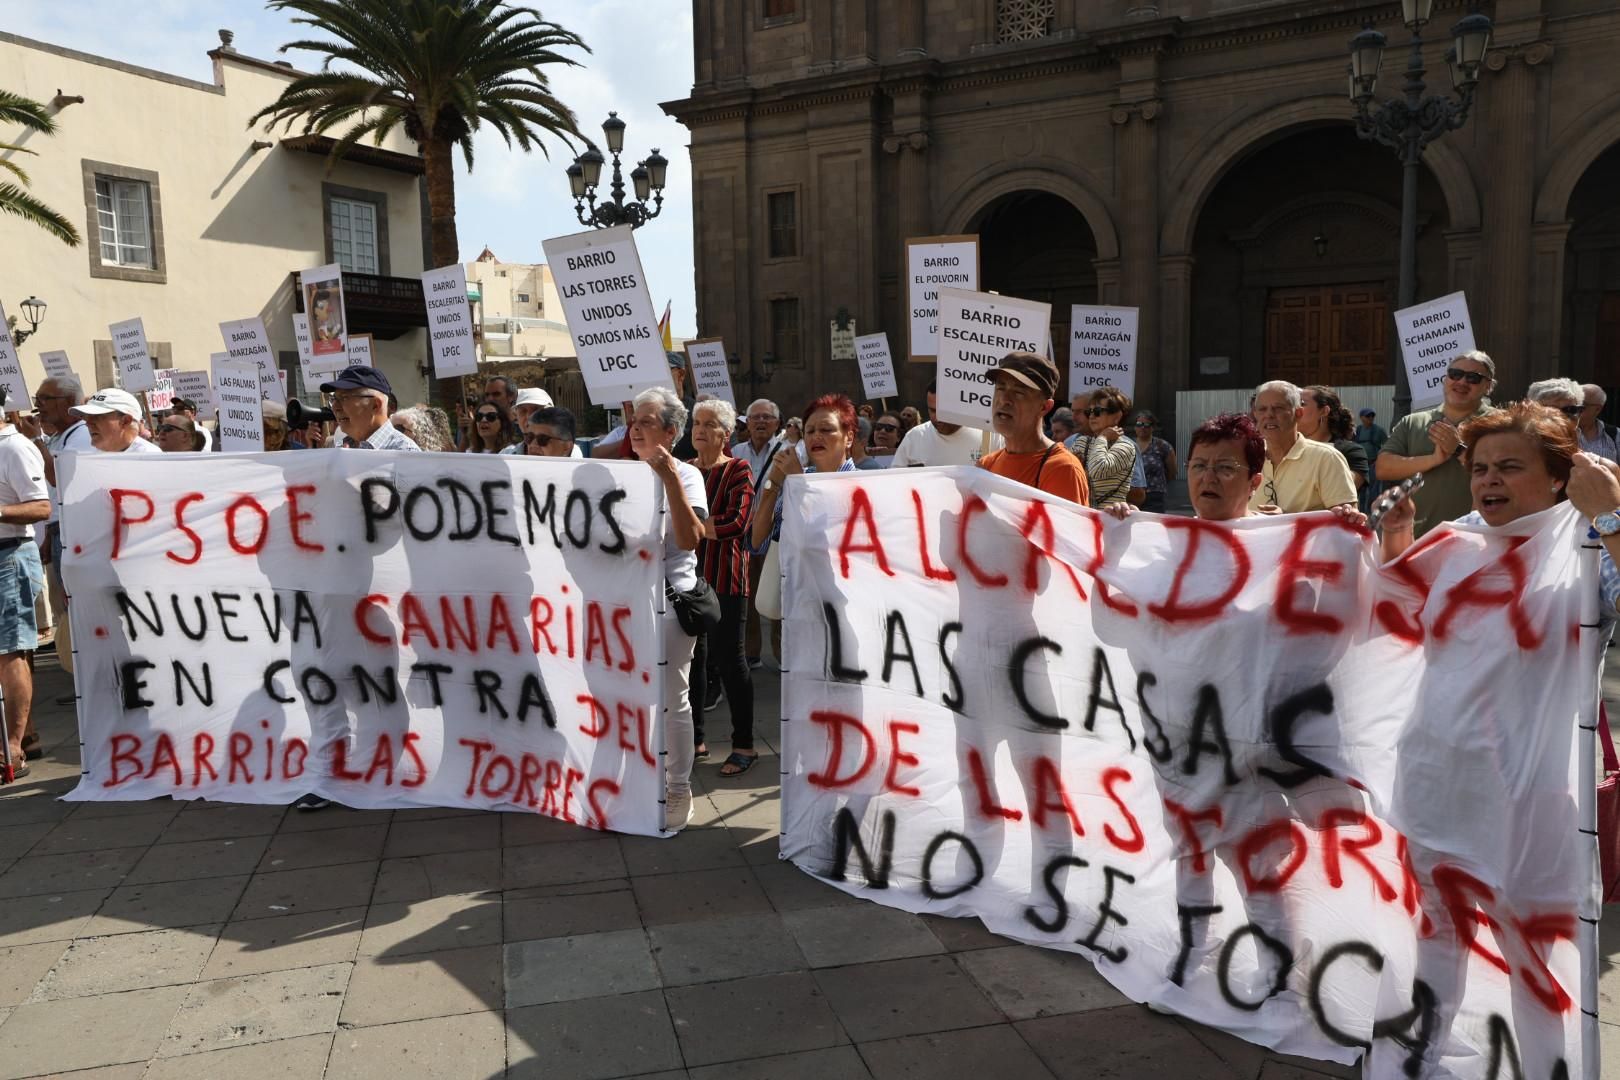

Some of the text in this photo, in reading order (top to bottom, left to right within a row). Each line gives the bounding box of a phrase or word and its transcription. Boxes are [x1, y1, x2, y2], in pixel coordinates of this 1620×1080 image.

[567, 250, 616, 271] BARRIO
[924, 256, 959, 268] BARRIO
[915, 273, 969, 284] EL POLVORIN
[433, 280, 456, 292] BARRIO
[562, 274, 637, 299] LAS TORRES
[428, 295, 465, 309] ESCALERITAS
[437, 312, 461, 325] UNIDOS
[581, 302, 632, 322] UNIDOS
[961, 309, 1021, 329] BARRIO
[1085, 316, 1122, 326] BARRIO
[1413, 311, 1451, 328] BARRIO
[119, 330, 140, 340] PALMAS
[232, 330, 257, 342] BARRIO
[433, 326, 469, 340] SOMOS MÁS
[577, 323, 650, 347] SOMOS MÁS
[1074, 330, 1131, 342] MARZAGÁN
[1405, 323, 1465, 346] SCHAMANN
[120, 341, 140, 351] UNIDOS
[862, 342, 881, 350] BARRIO
[943, 327, 1037, 354] ESCALERITAS
[229, 345, 268, 358] MARZAGÁN
[442, 345, 461, 357] LPGC
[1083, 346, 1121, 357] UNIDOS
[1418, 340, 1459, 358] UNIDOS
[119, 353, 136, 362] SOMOS
[598, 353, 638, 372] LPGC
[126, 363, 142, 372] LPGC
[865, 361, 885, 369] UNIDOS
[1074, 361, 1129, 372] SOMOS MÁS
[1412, 359, 1447, 375] SOMOS
[220, 376, 256, 389] LAS PALMAS
[261, 373, 276, 383] MÁS
[870, 380, 886, 389] LPGC
[1083, 376, 1112, 387] LPGC
[960, 390, 992, 407] LPG
[228, 409, 254, 422] UNIDOS
[223, 427, 260, 441] SOMOS MÁS
[116, 590, 322, 649] NUEVA
[823, 600, 1340, 790] LAS CASAS
[120, 658, 657, 769] EN CONTRA DEL
[329, 732, 427, 788] LAS
[458, 738, 621, 831] TORRES
[807, 709, 920, 797] DE
[968, 746, 1145, 853] LAS
[830, 807, 984, 900] NO
[1024, 854, 1136, 963] SE
